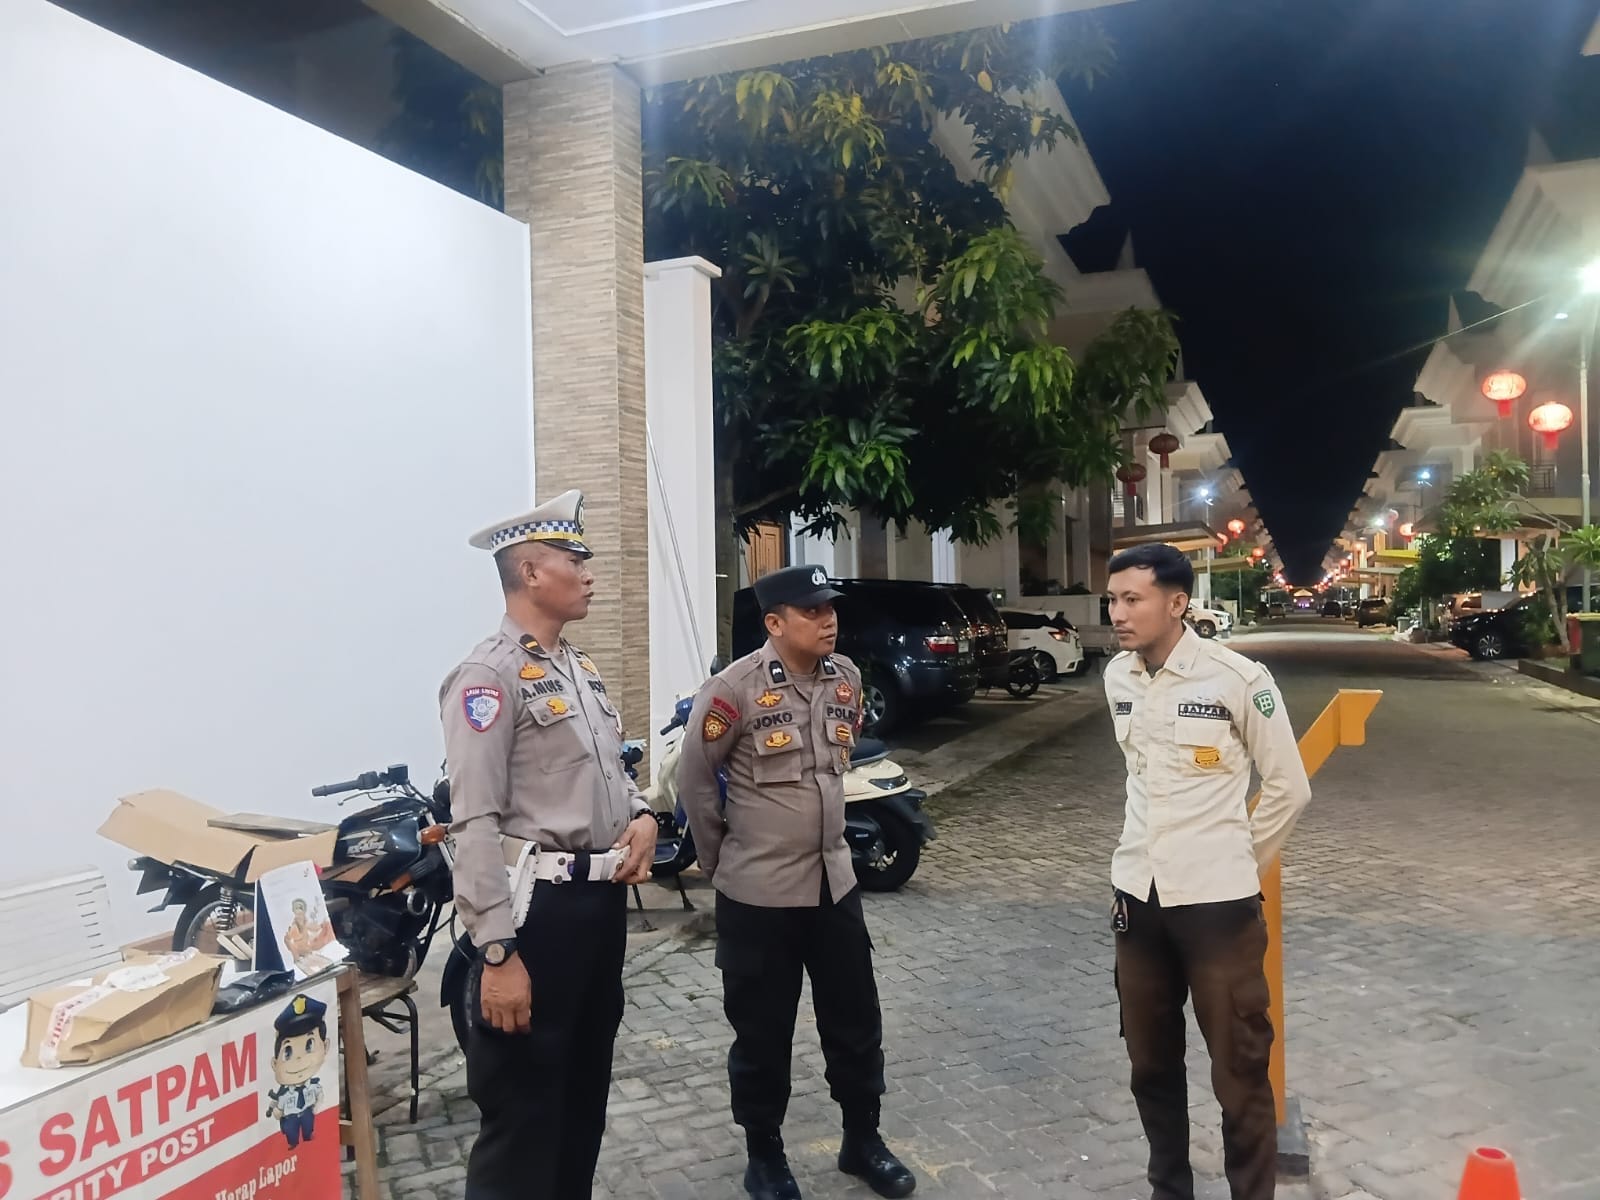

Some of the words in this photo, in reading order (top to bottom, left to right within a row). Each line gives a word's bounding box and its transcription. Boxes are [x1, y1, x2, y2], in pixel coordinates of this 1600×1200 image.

[752, 711, 793, 730] JOKO
[38, 1032, 258, 1177] SATPAM
[141, 1118, 215, 1177] POST
[258, 1154, 298, 1190] Lapor
